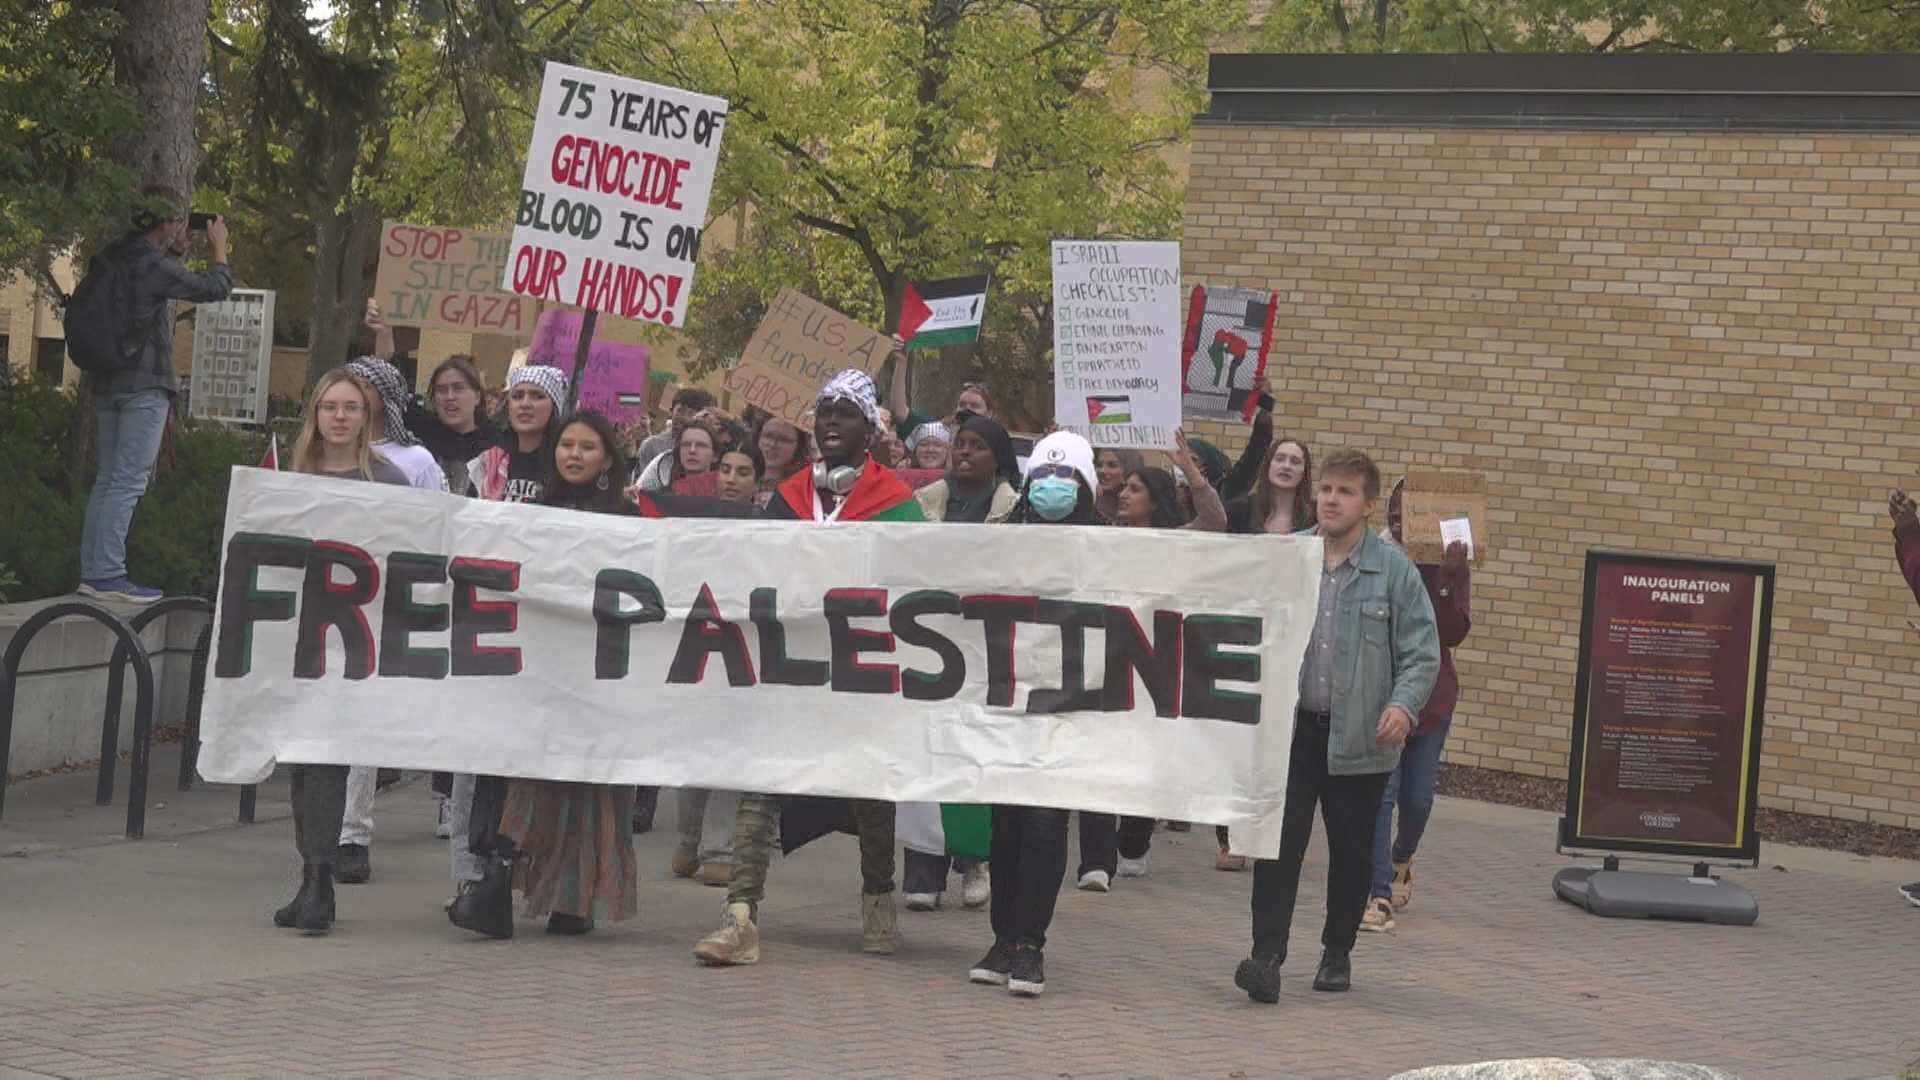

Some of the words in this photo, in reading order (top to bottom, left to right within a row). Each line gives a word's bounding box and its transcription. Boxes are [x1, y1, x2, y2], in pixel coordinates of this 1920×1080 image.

[558, 79, 595, 119] 75
[609, 89, 689, 139] YEARS
[694, 109, 726, 148] OF
[551, 134, 690, 210] GENOCIDE
[517, 190, 601, 240] BLOOD
[615, 211, 653, 250] IS
[666, 224, 702, 262] ON
[385, 226, 462, 261] STOP
[1056, 244, 1120, 265] ISRAELI
[405, 260, 511, 295] SIEGE
[512, 245, 567, 302] OUR
[576, 258, 683, 325] HANDS!
[1089, 266, 1179, 286] OCCUPATION
[1060, 283, 1156, 302] CHECKLIST:
[387, 291, 432, 319] IN
[440, 295, 521, 330] GAZA
[1075, 306, 1130, 320] GENOCIDE
[1074, 324, 1108, 338] ETHNIC
[728, 363, 809, 422] GENOCI
[1078, 377, 1103, 391] FAKE
[1089, 424, 1167, 445] PALESTINE!!!
[1623, 575, 1730, 592] INAUGURATION
[1651, 591, 1705, 604] PANELS
[214, 531, 523, 680] FREE
[593, 567, 1263, 725] PALESTINE
